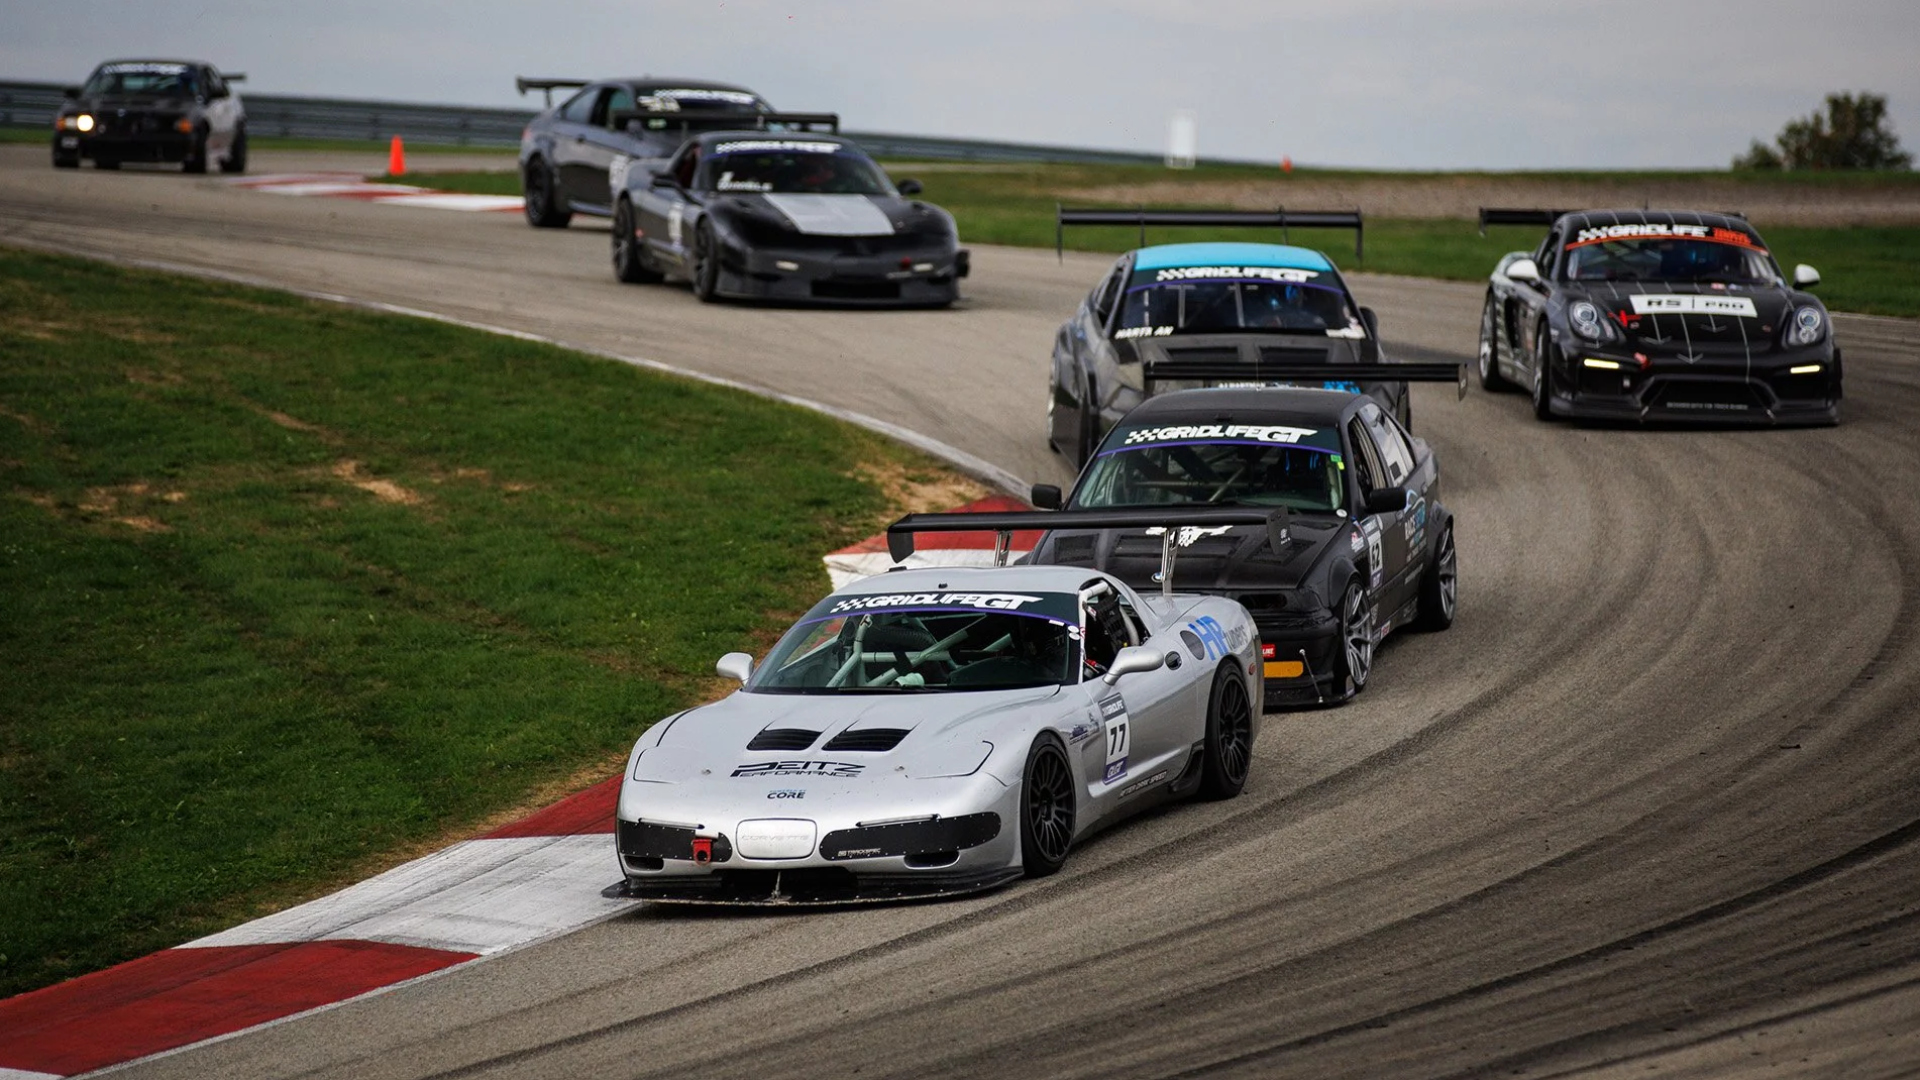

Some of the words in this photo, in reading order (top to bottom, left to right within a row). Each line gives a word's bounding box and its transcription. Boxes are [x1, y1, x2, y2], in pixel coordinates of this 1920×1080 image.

[1607, 224, 1709, 238] GRIDLIFE
[1188, 615, 1229, 661] HP
[1110, 723, 1126, 756] 77
[767, 791, 806, 799] CORE
